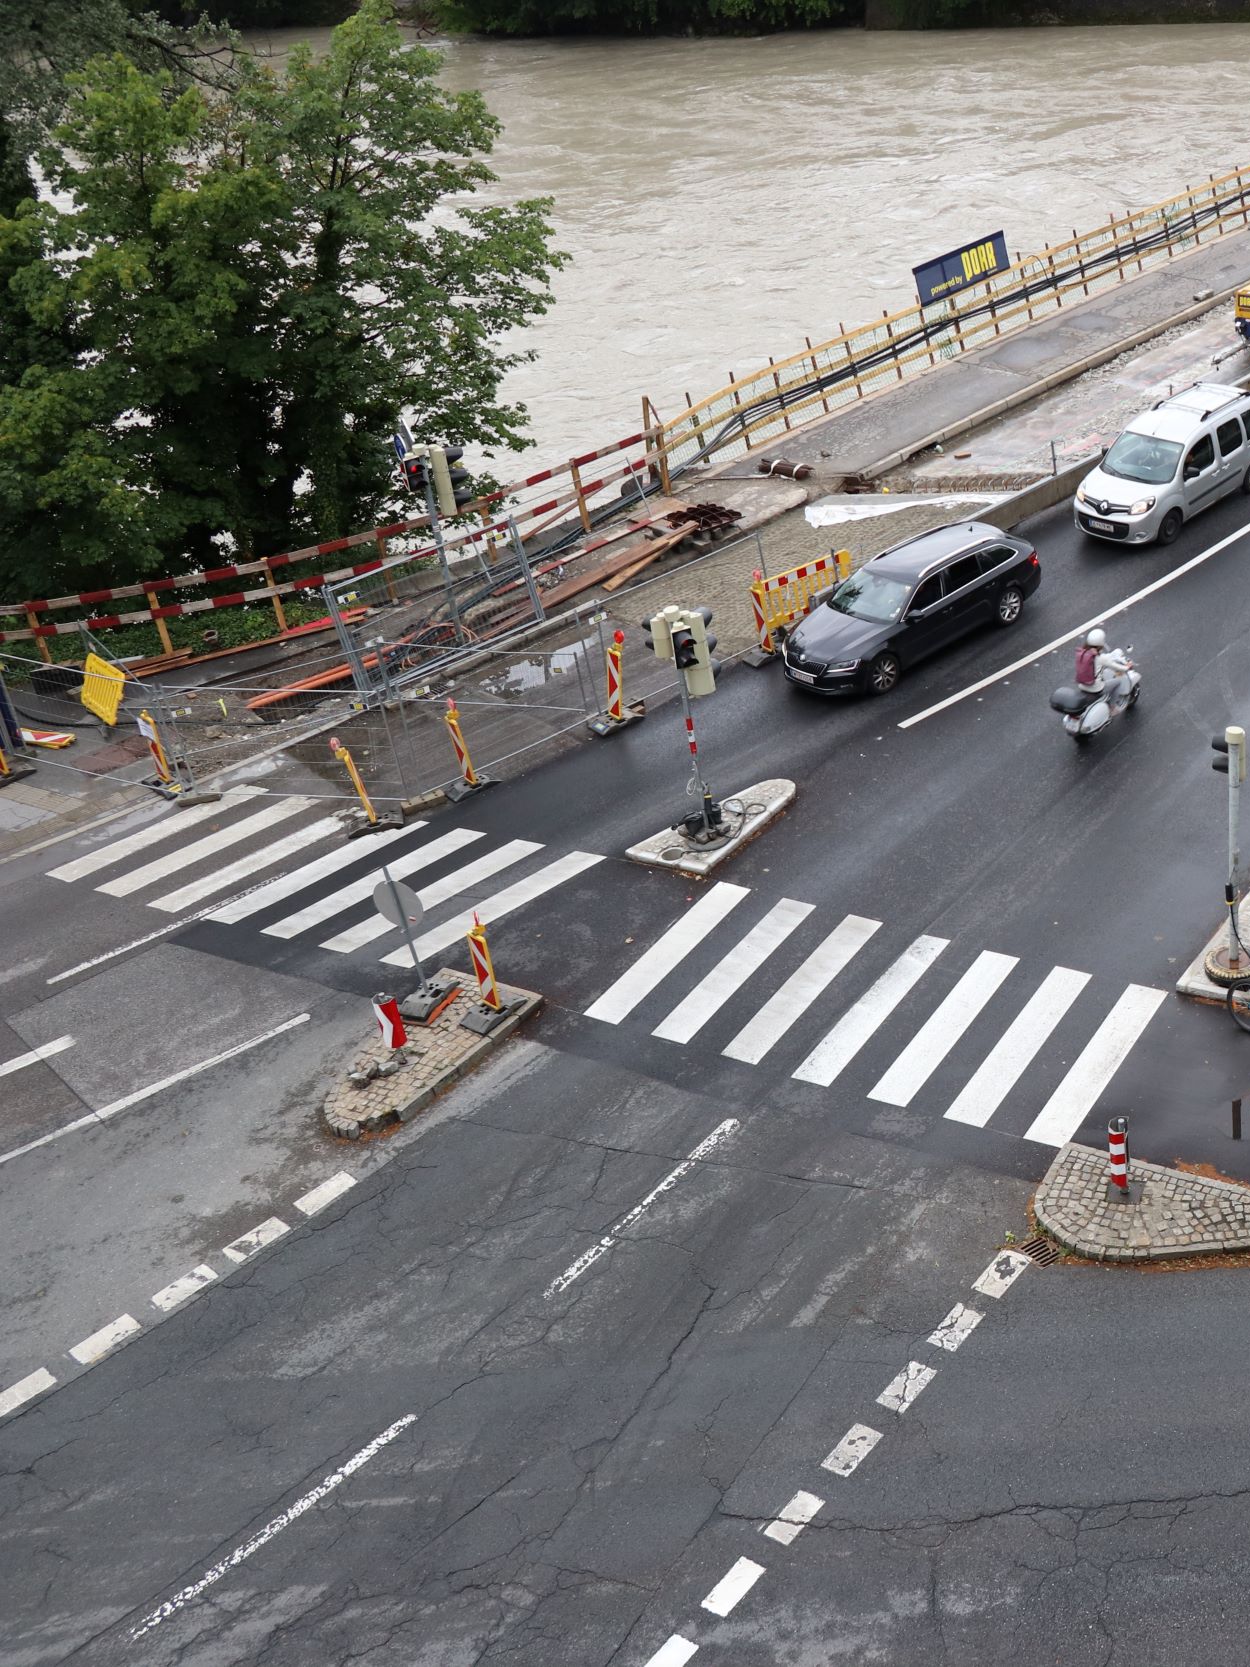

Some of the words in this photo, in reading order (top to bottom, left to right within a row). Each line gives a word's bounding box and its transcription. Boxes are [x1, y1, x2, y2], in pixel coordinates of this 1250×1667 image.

[931, 276, 955, 296] powered
[955, 275, 962, 284] by
[961, 241, 996, 281] PORR
